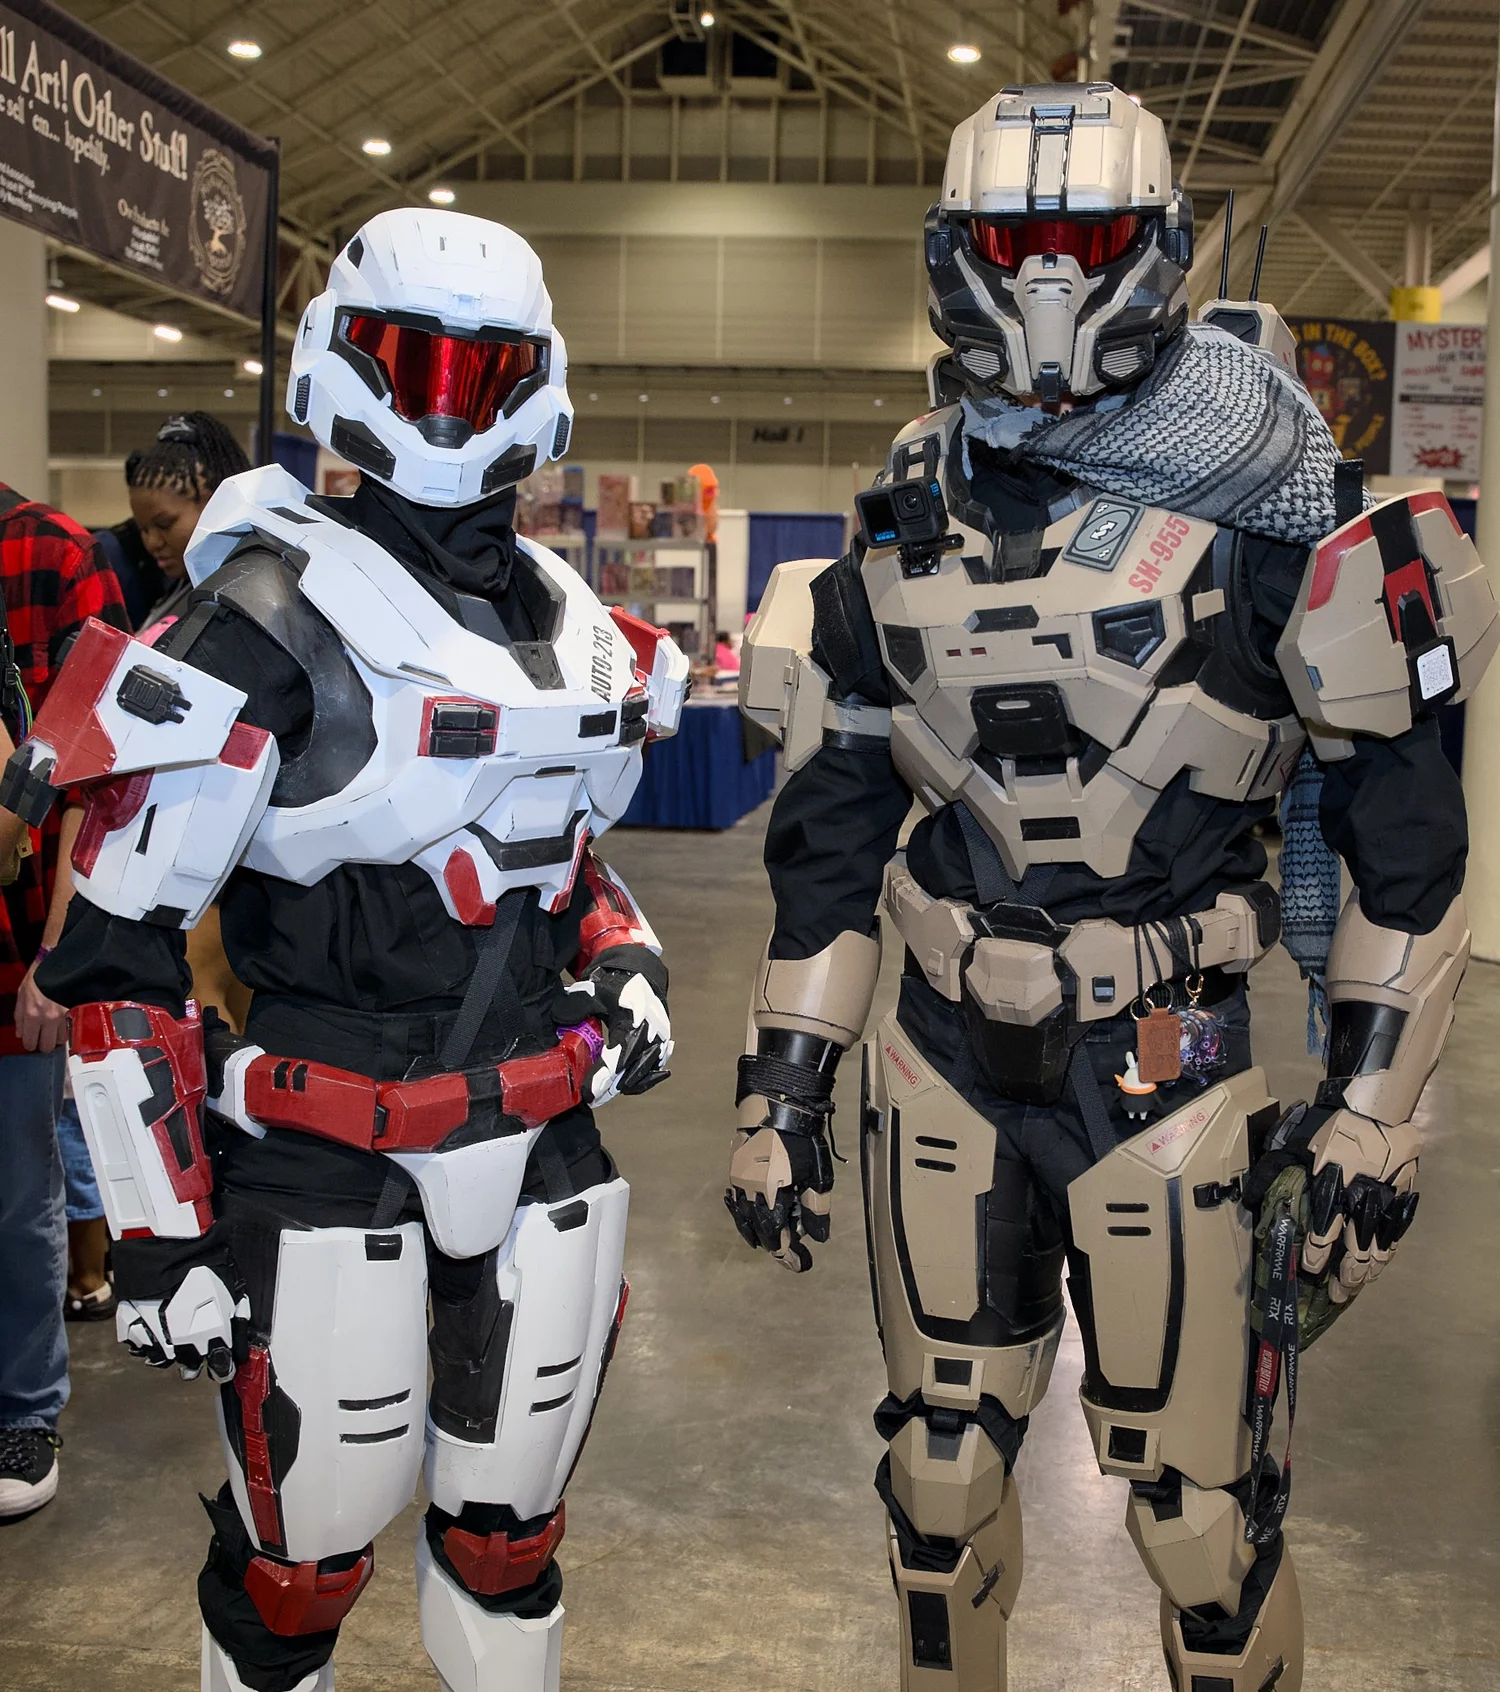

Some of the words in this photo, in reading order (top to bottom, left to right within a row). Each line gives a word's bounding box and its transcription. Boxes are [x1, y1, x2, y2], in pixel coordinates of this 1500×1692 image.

[21, 40, 68, 112] Art!
[72, 72, 135, 151] Other
[140, 110, 188, 181] Stuff!
[1407, 327, 1485, 351] MYSTER
[1128, 514, 1190, 594] SH-955
[591, 625, 613, 703] AUTO-213
[890, 1049, 918, 1085] WARNING
[1272, 1218, 1291, 1281] WARFRAME
[1252, 1404, 1265, 1462] WARFRAME
